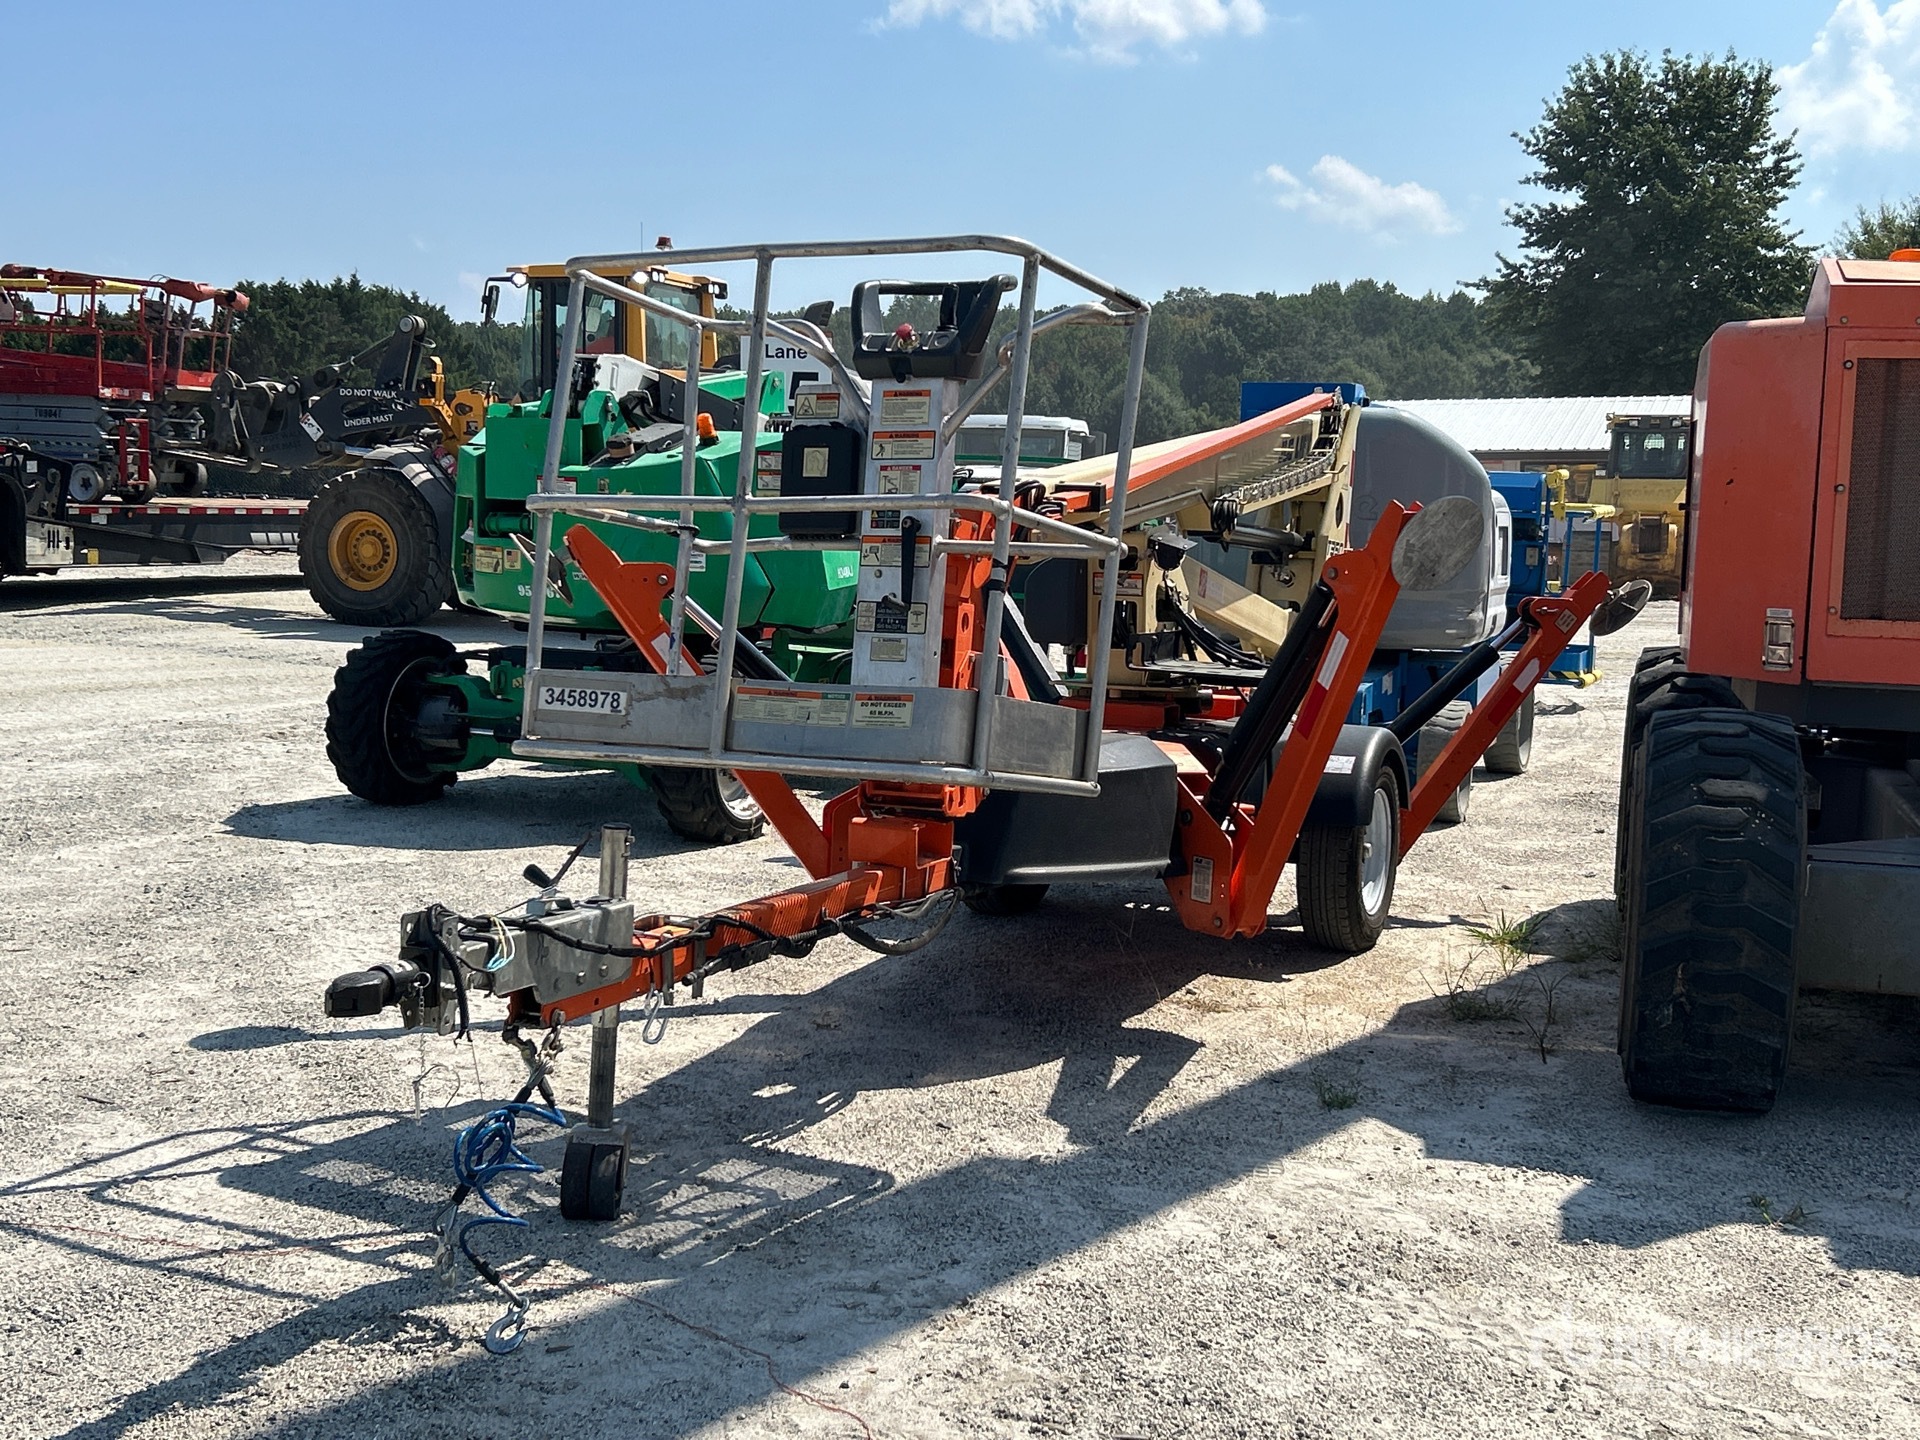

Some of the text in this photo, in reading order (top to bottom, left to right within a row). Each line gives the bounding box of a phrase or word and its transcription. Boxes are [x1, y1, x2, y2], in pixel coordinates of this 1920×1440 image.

[765, 343, 808, 359] Lane
[339, 388, 397, 399] DO NOT WALK
[343, 414, 393, 428] UNDER MAST
[544, 687, 621, 710] 3458978
